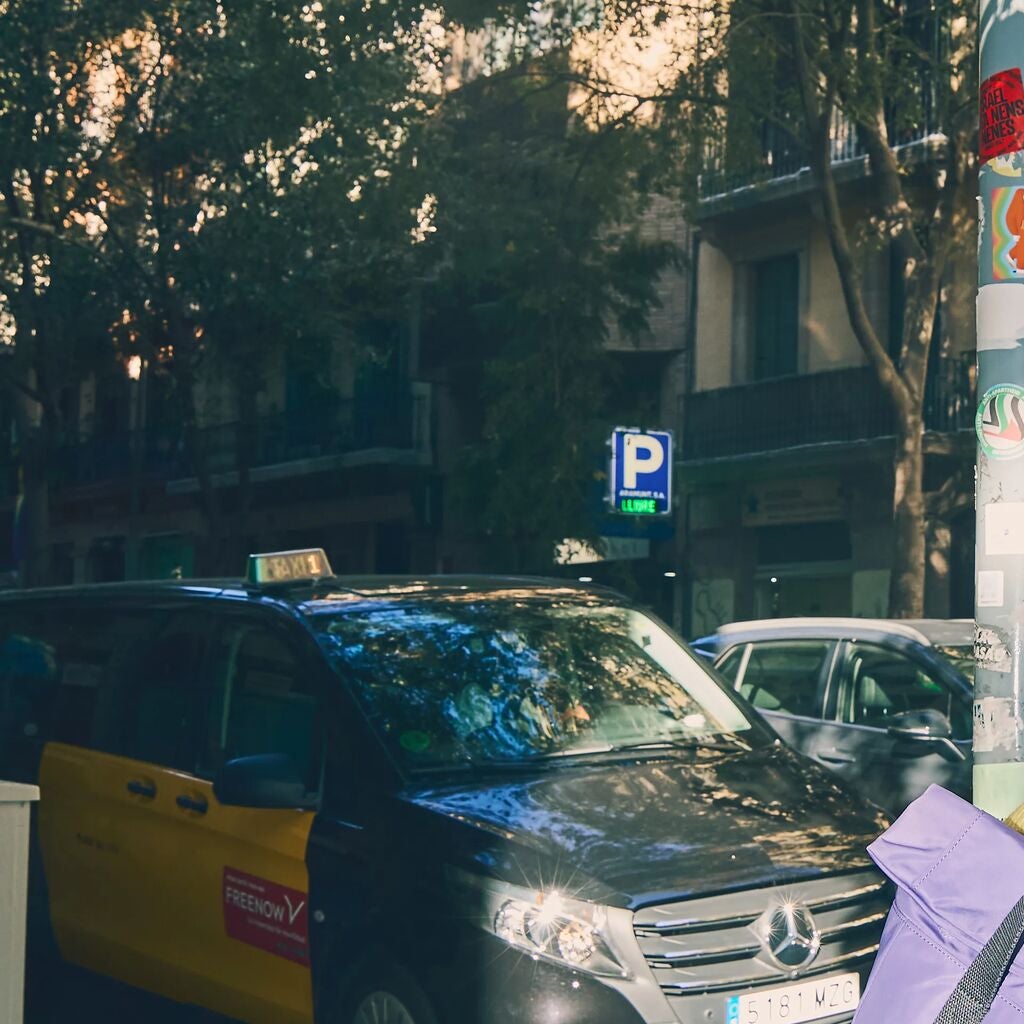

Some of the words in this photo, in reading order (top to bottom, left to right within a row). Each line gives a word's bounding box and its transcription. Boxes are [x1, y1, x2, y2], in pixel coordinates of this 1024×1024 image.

[623, 433, 665, 490] P
[226, 886, 285, 922] FREENOW
[747, 991, 803, 1024] 5181
[814, 980, 854, 1011] MZG
